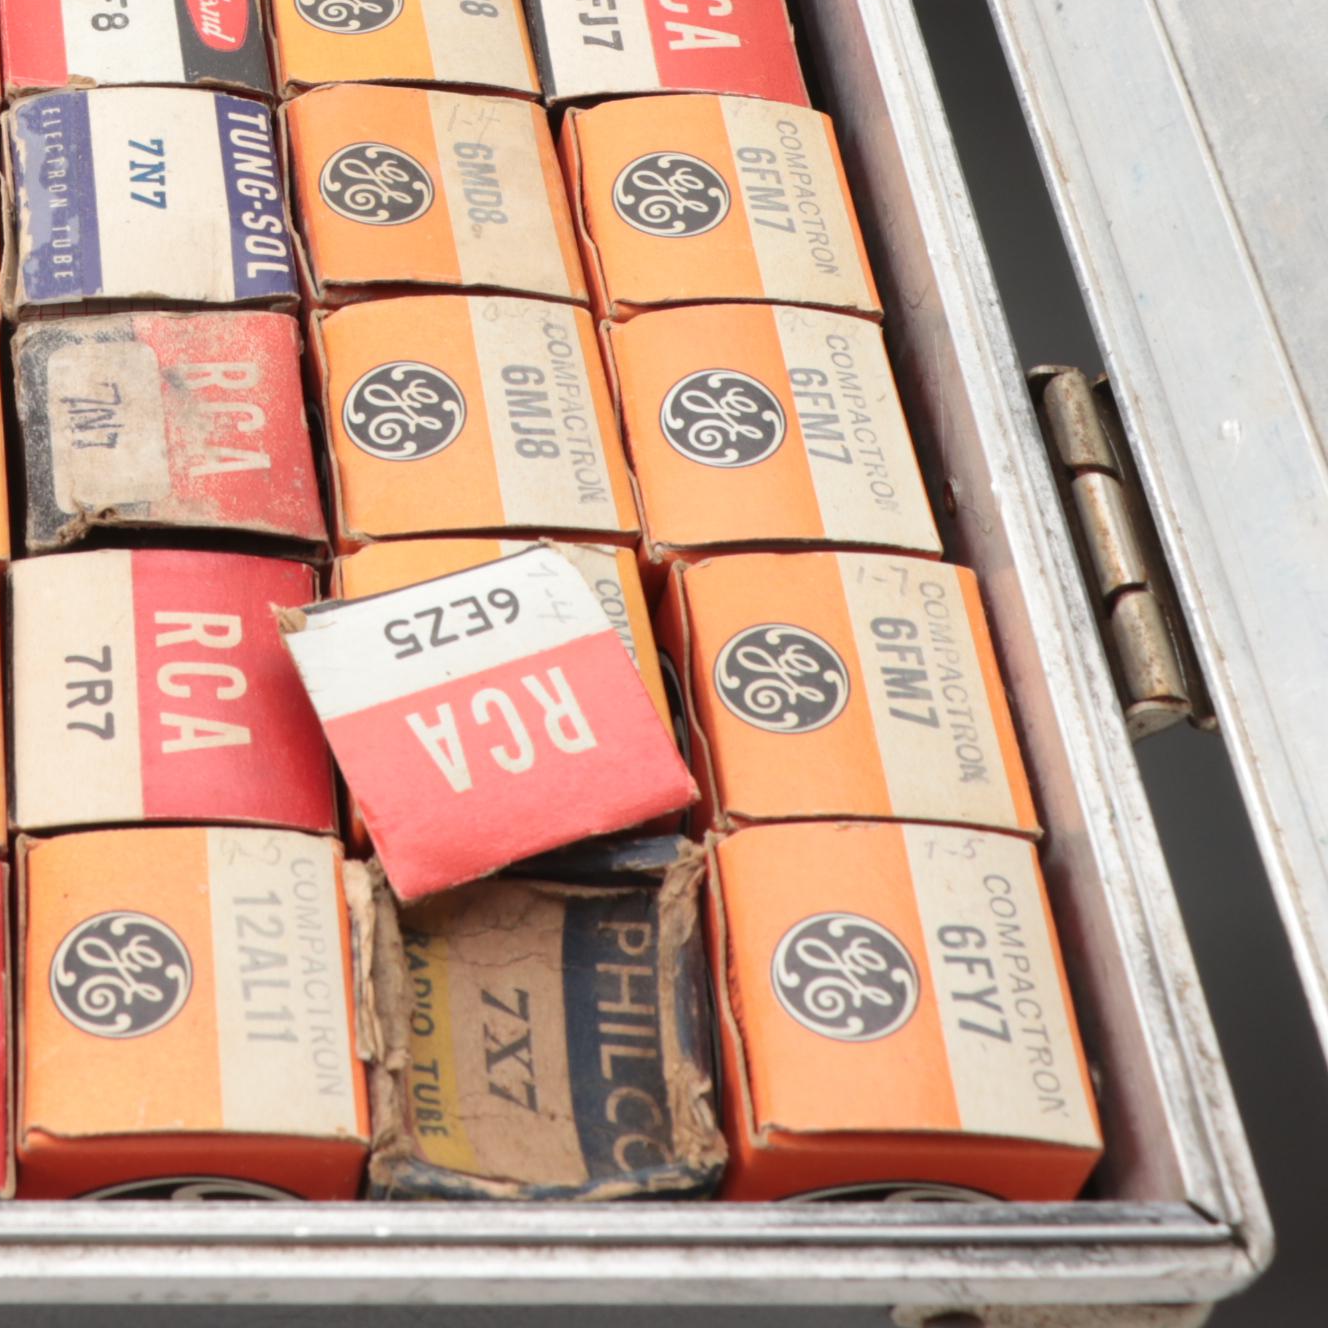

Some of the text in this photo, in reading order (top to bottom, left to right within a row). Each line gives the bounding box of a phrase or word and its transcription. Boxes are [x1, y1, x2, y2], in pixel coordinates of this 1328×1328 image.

[40, 108, 74, 280] ELECTRON TUBE
[127, 138, 168, 211] 7N7
[226, 111, 290, 279] TUNG-SOL
[452, 141, 509, 225] 6MD8
[736, 146, 796, 234] 6FM7
[776, 120, 841, 277] COMPACTRON
[177, 361, 271, 475] RCA
[500, 363, 560, 459] 6MJ8
[544, 322, 608, 504] COMPACTRON
[789, 366, 852, 466] 6FM7
[826, 333, 898, 515] COMPACTRON
[154, 611, 251, 754] RCA
[383, 586, 521, 660] 6EZ5
[870, 615, 941, 731] 6FM7
[918, 580, 991, 784] COMPACTRON
[64, 645, 114, 740] 7R7
[405, 666, 597, 793] RCA
[232, 890, 301, 1045] 12AL11
[289, 857, 345, 1097] COMPACTRON
[936, 924, 1011, 1043] 6FY7
[982, 874, 1069, 1118] COMPACTRON
[412, 1059, 449, 1139] TUBE
[480, 986, 537, 1112] 7X7
